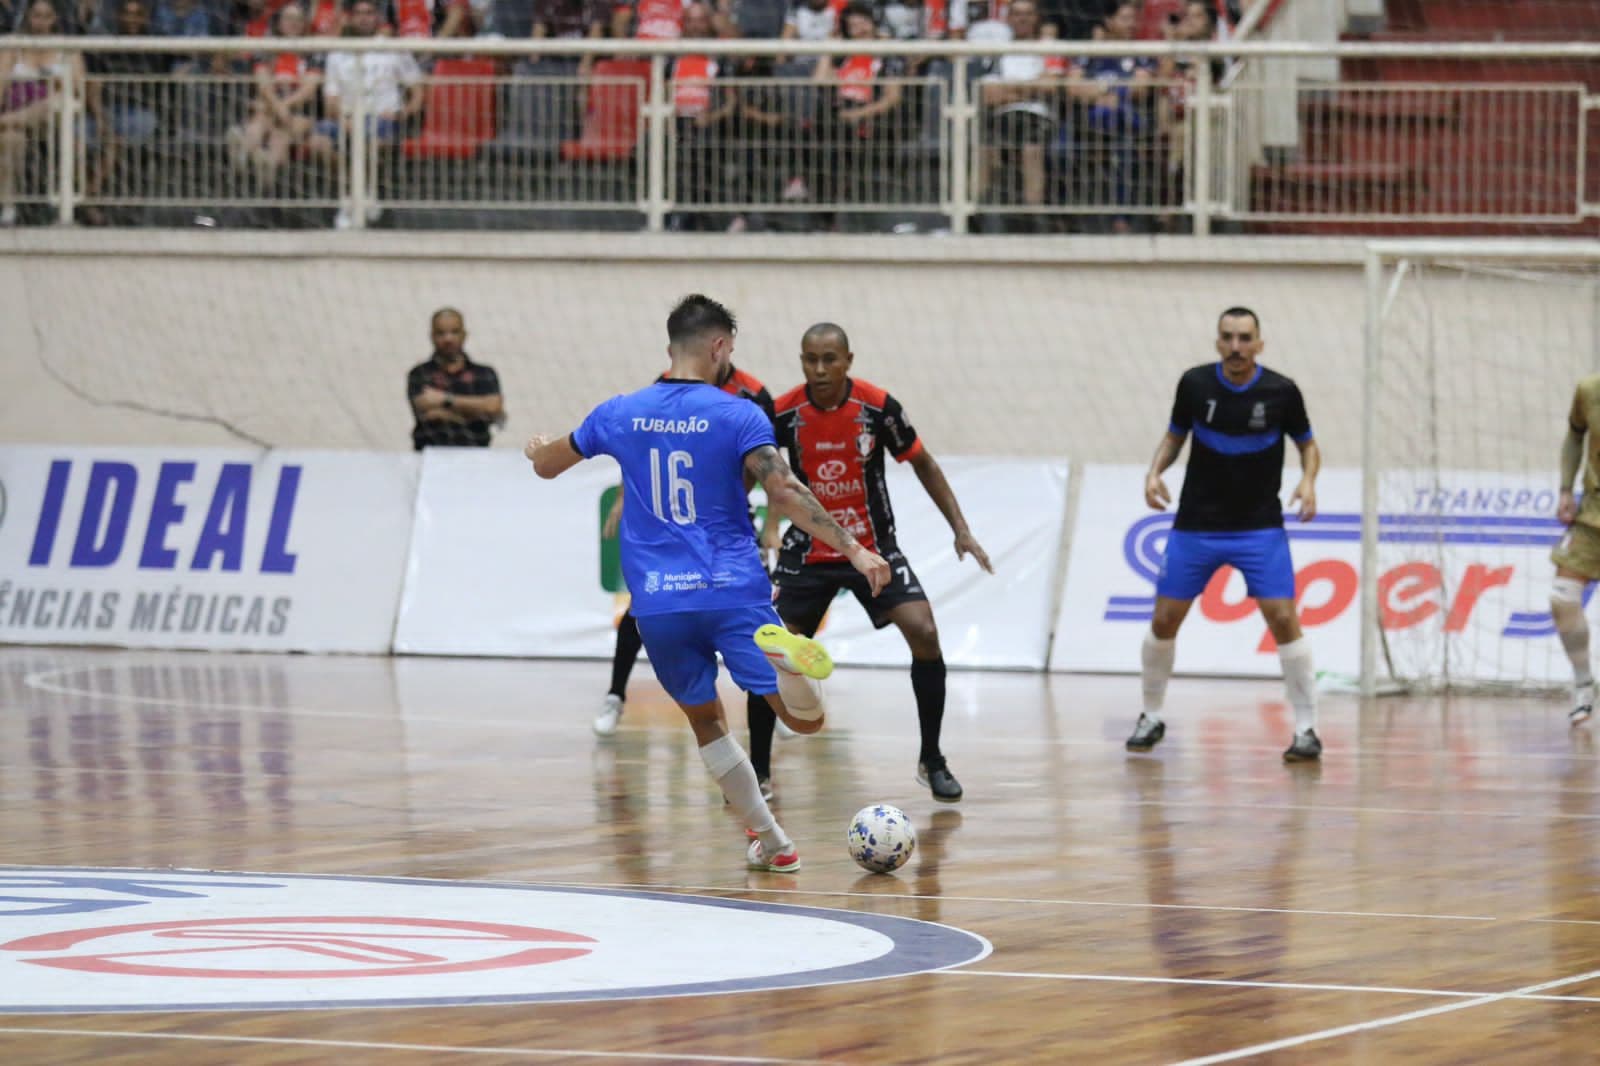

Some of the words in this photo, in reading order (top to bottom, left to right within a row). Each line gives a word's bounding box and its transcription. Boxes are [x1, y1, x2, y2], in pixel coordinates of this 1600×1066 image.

[631, 415, 710, 434] TUBARÃO
[649, 447, 697, 526] 16
[27, 459, 304, 574] IDEAL
[895, 565, 911, 586] 7
[128, 584, 292, 636] MÉDICAS
